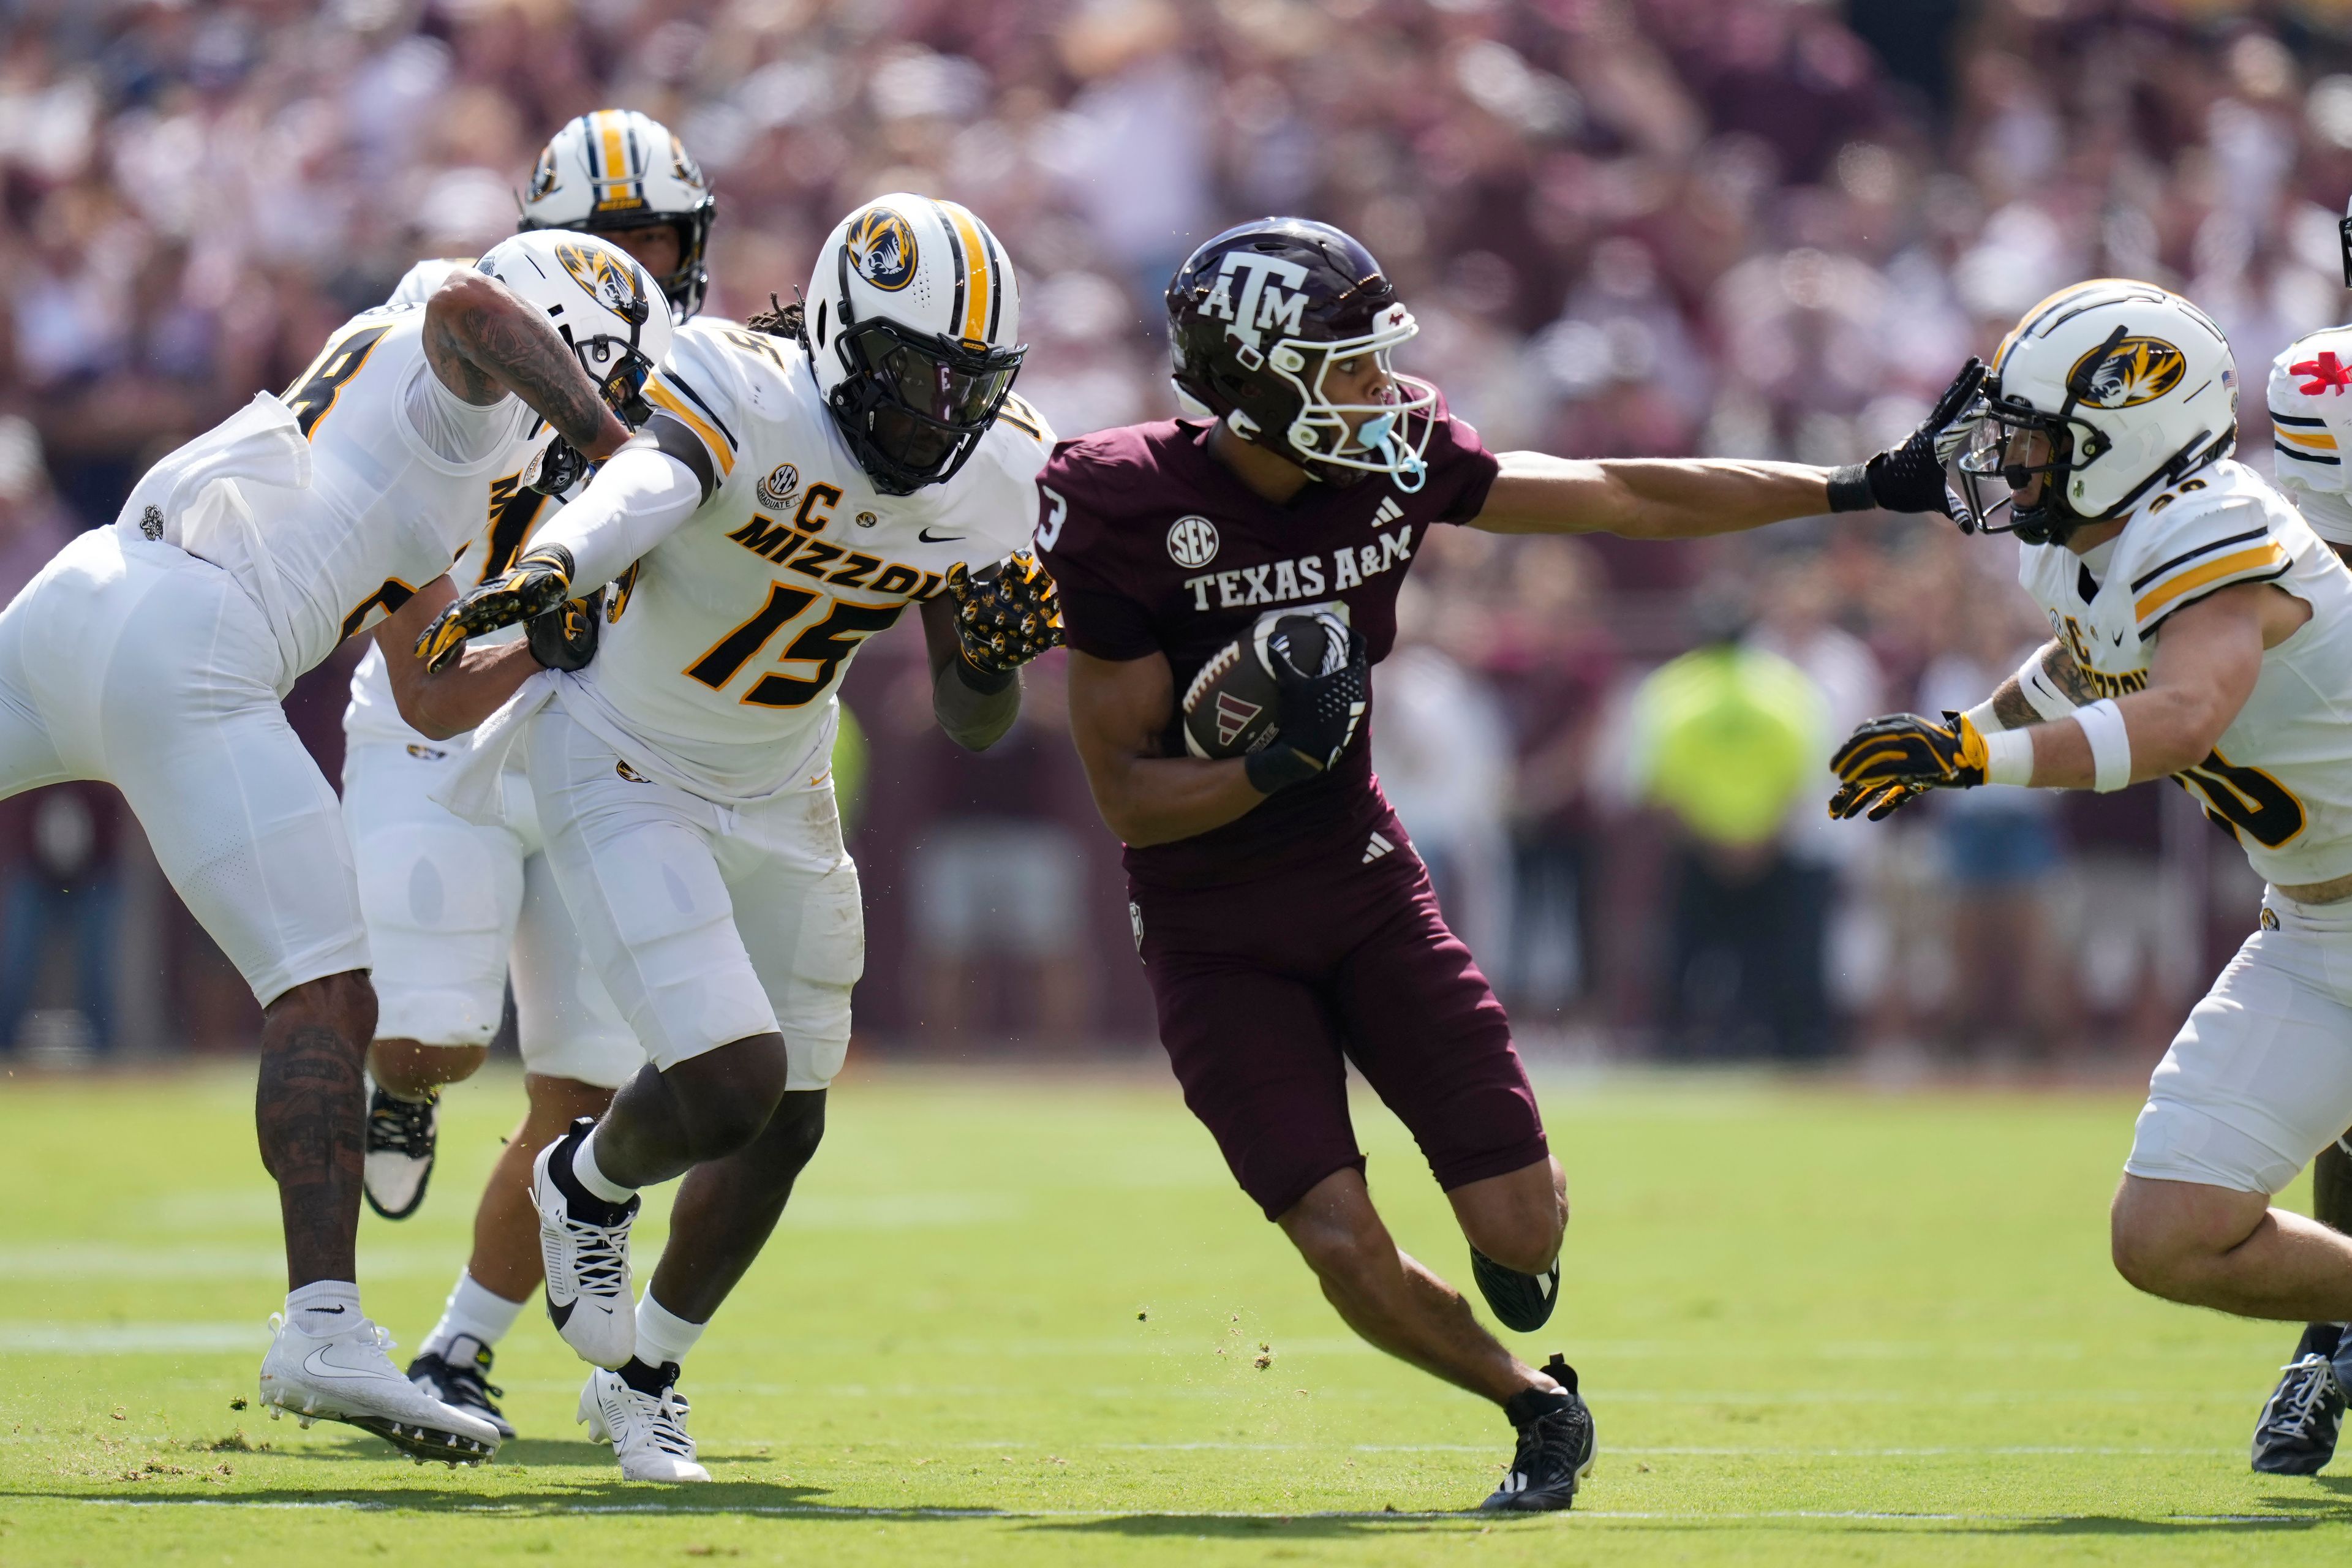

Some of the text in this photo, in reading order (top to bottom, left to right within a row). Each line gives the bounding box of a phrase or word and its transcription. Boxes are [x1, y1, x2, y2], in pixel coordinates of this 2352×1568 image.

[758, 488, 791, 509] GRADUATE
[769, 464, 798, 494] SEC
[794, 481, 844, 534] C
[1036, 484, 1068, 553] 3
[1169, 518, 1216, 565] SEC
[1184, 524, 1412, 611] TEXAS A&M
[682, 579, 911, 709] 15
